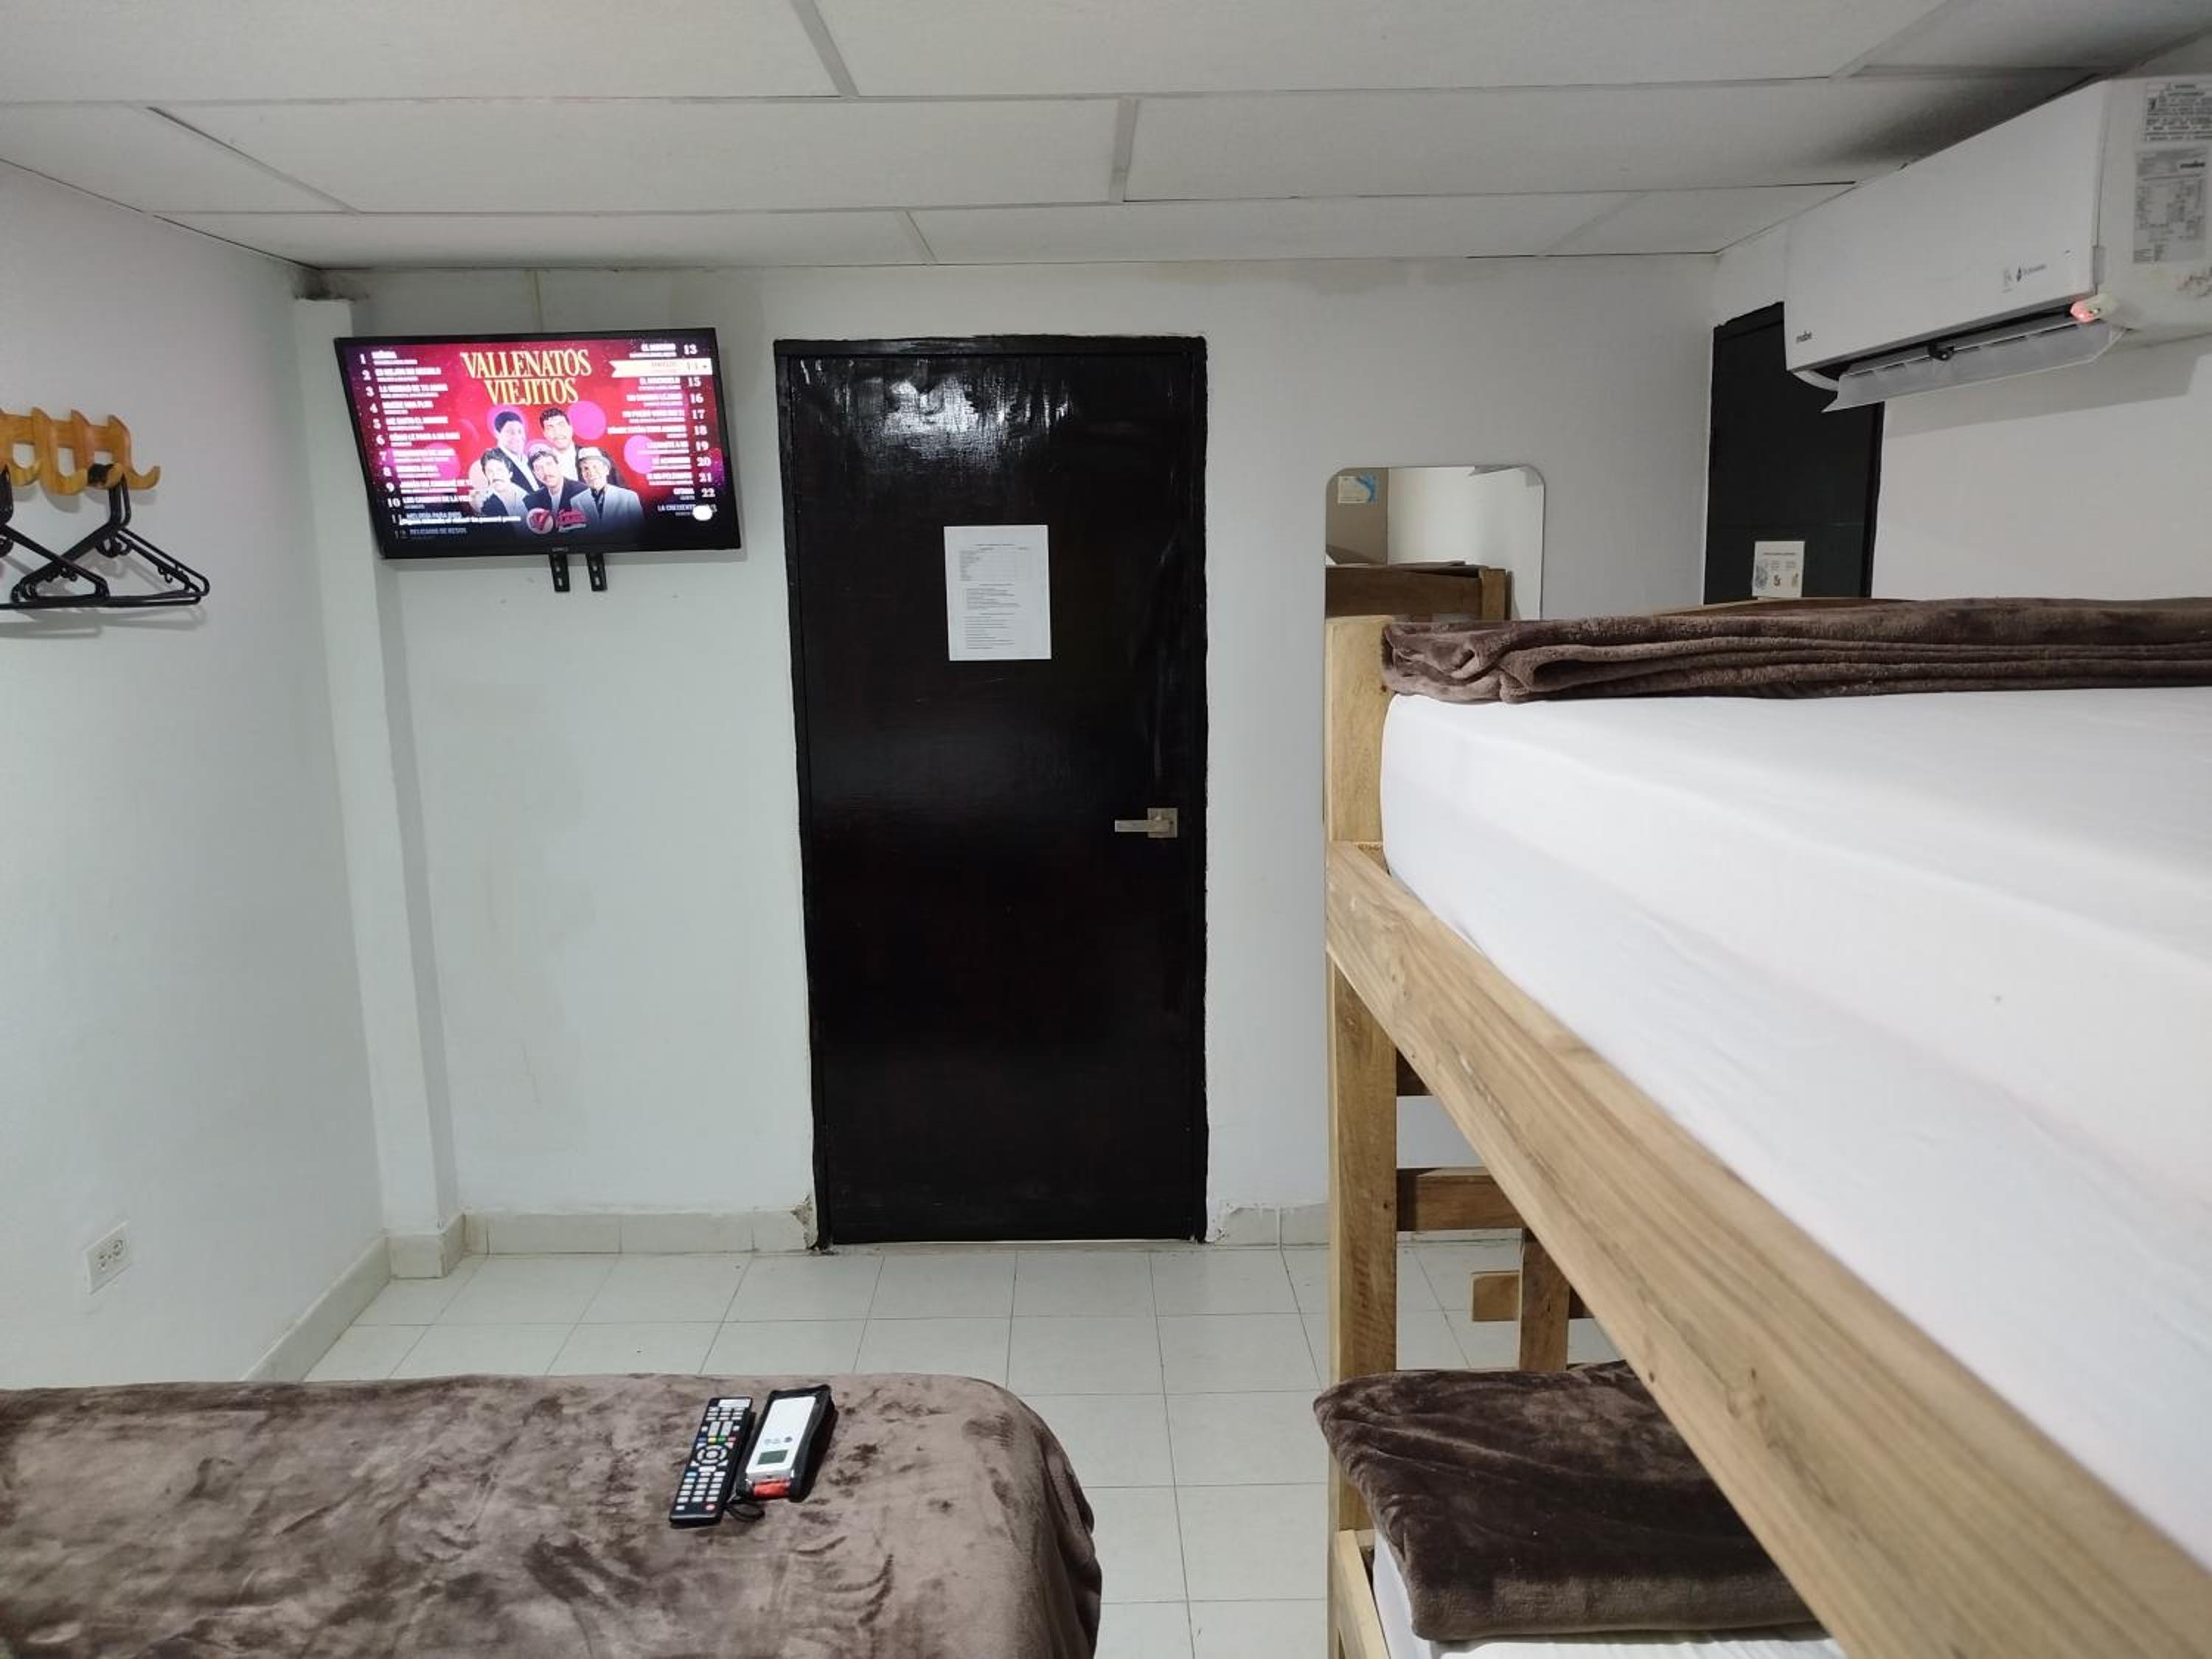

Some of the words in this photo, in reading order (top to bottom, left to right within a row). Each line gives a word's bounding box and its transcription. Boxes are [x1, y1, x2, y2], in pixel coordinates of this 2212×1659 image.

[684, 344, 698, 355] 13
[360, 354, 366, 364] 1
[459, 348, 592, 378] VALLENATOS
[362, 369, 372, 380] 2
[688, 377, 702, 387] 15
[366, 386, 375, 397] 3
[484, 378, 579, 406] VIEJITOS
[690, 393, 704, 403] 16
[369, 403, 378, 413] 4
[692, 409, 706, 420] 17
[372, 419, 381, 429] 5
[694, 425, 708, 436] 18
[376, 435, 385, 445] 6
[695, 441, 709, 451] 19
[379, 451, 387, 461] 7
[696, 456, 712, 467] 20
[383, 467, 392, 476] 8
[698, 473, 712, 483] 21
[386, 481, 394, 493] 9
[701, 488, 716, 498] 22
[387, 498, 400, 507] 10
